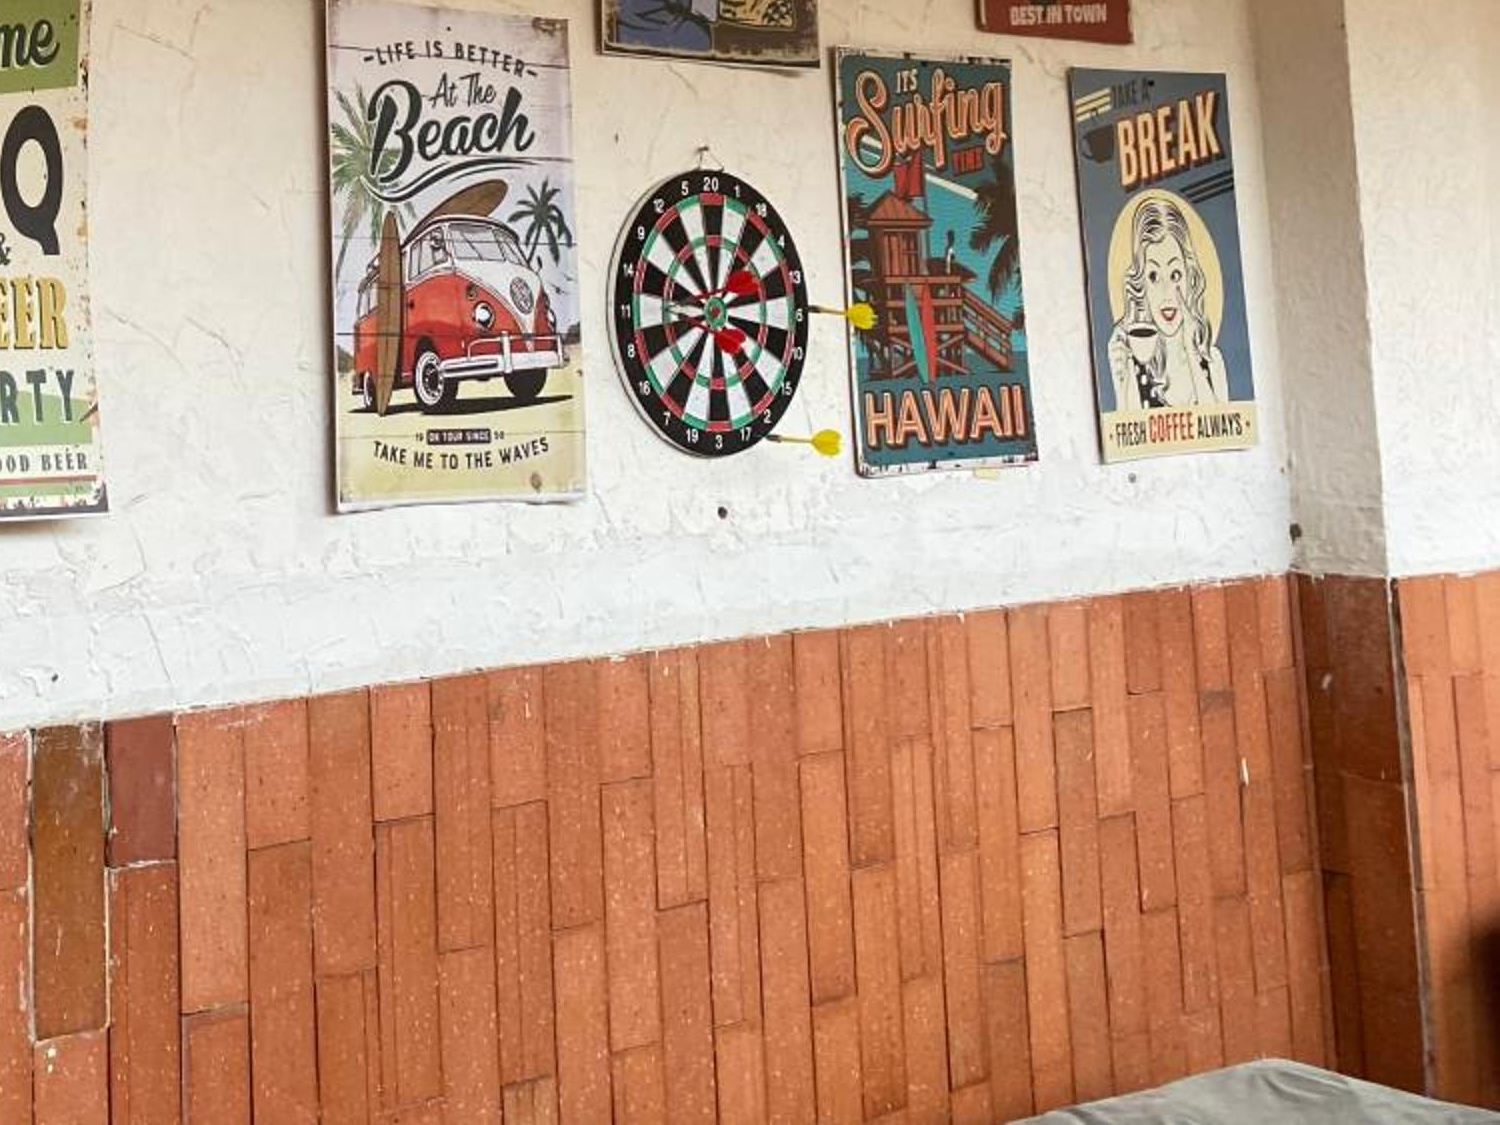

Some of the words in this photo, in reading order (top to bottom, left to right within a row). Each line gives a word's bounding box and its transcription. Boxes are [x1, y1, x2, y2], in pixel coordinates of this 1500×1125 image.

[1010, 5, 1045, 26] BEST
[1046, 4, 1062, 24] IN
[1064, 3, 1107, 24] TOWN
[425, 40, 443, 58] IS
[429, 72, 457, 108] At
[459, 72, 497, 108] The
[845, 67, 1007, 173] Surfing
[367, 79, 536, 184] Beach
[1117, 90, 1222, 188] BREAK
[681, 180, 690, 195] 5
[703, 176, 719, 192] 20
[734, 184, 740, 198] 1
[653, 198, 665, 214] 12
[637, 226, 645, 241] 9
[777, 234, 785, 249] 4
[623, 262, 634, 278] 14
[788, 269, 801, 285] 13
[621, 304, 631, 319] 11
[627, 343, 636, 358] 8
[791, 346, 803, 360] 10
[639, 380, 651, 395] 16
[781, 382, 793, 396] 15
[663, 411, 671, 426] 7
[763, 409, 771, 424] 2
[865, 383, 1026, 448] HAWAII
[686, 428, 699, 443] 19
[740, 426, 752, 442] 17
[1115, 422, 1147, 448] FRESH
[1149, 412, 1194, 443] COFFEE
[1197, 413, 1243, 439] ALWAYS
[714, 435, 723, 449] 3
[41, 450, 88, 472] BEER
[374, 441, 407, 465] TAKE
[413, 452, 433, 469] ME
[440, 453, 458, 470] TO
[466, 451, 493, 469] THE
[500, 437, 549, 464] WAVES
